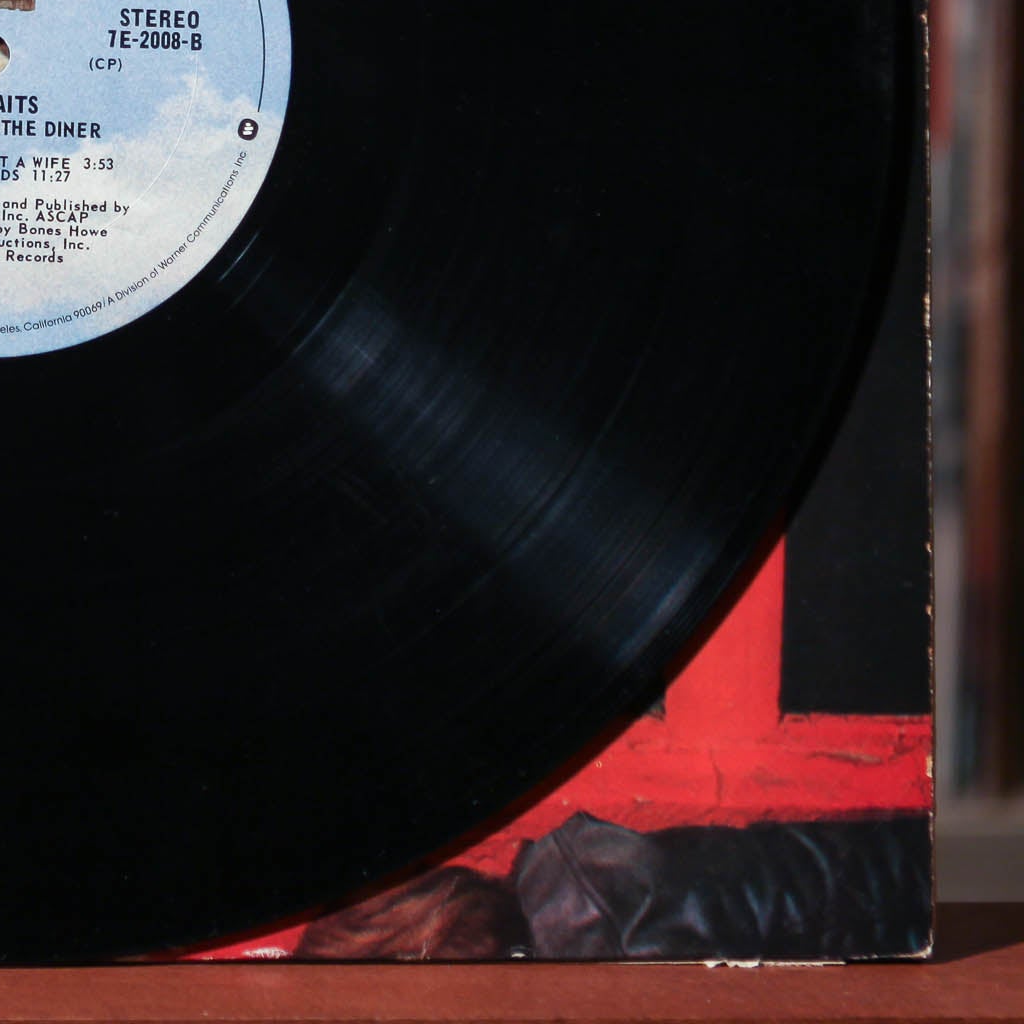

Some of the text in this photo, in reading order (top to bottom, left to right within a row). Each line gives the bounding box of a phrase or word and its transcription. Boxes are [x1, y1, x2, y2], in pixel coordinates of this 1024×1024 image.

[119, 8, 200, 29] STEREO
[108, 29, 203, 52] 7E-2008-B
[88, 56, 123, 72] (CP)
[1, 120, 36, 137] THE
[44, 121, 102, 139] DINER
[16, 156, 26, 169] A
[33, 157, 71, 170] WIFE
[83, 157, 114, 171] 3:53
[32, 170, 71, 183] 11:27
[2, 197, 27, 210] and
[35, 198, 107, 212] Published
[114, 201, 130, 215] by
[2, 209, 29, 222] Inc.
[36, 210, 89, 224] ASCAP
[19, 223, 62, 236] Bones
[70, 225, 108, 237] Howe
[23, 313, 73, 332] California
[115, 277, 150, 301] Division
[149, 268, 160, 279] of
[158, 241, 189, 271] Warner
[187, 169, 240, 244] Communications
[63, 238, 90, 251] Inc.
[6, 250, 64, 263] Records
